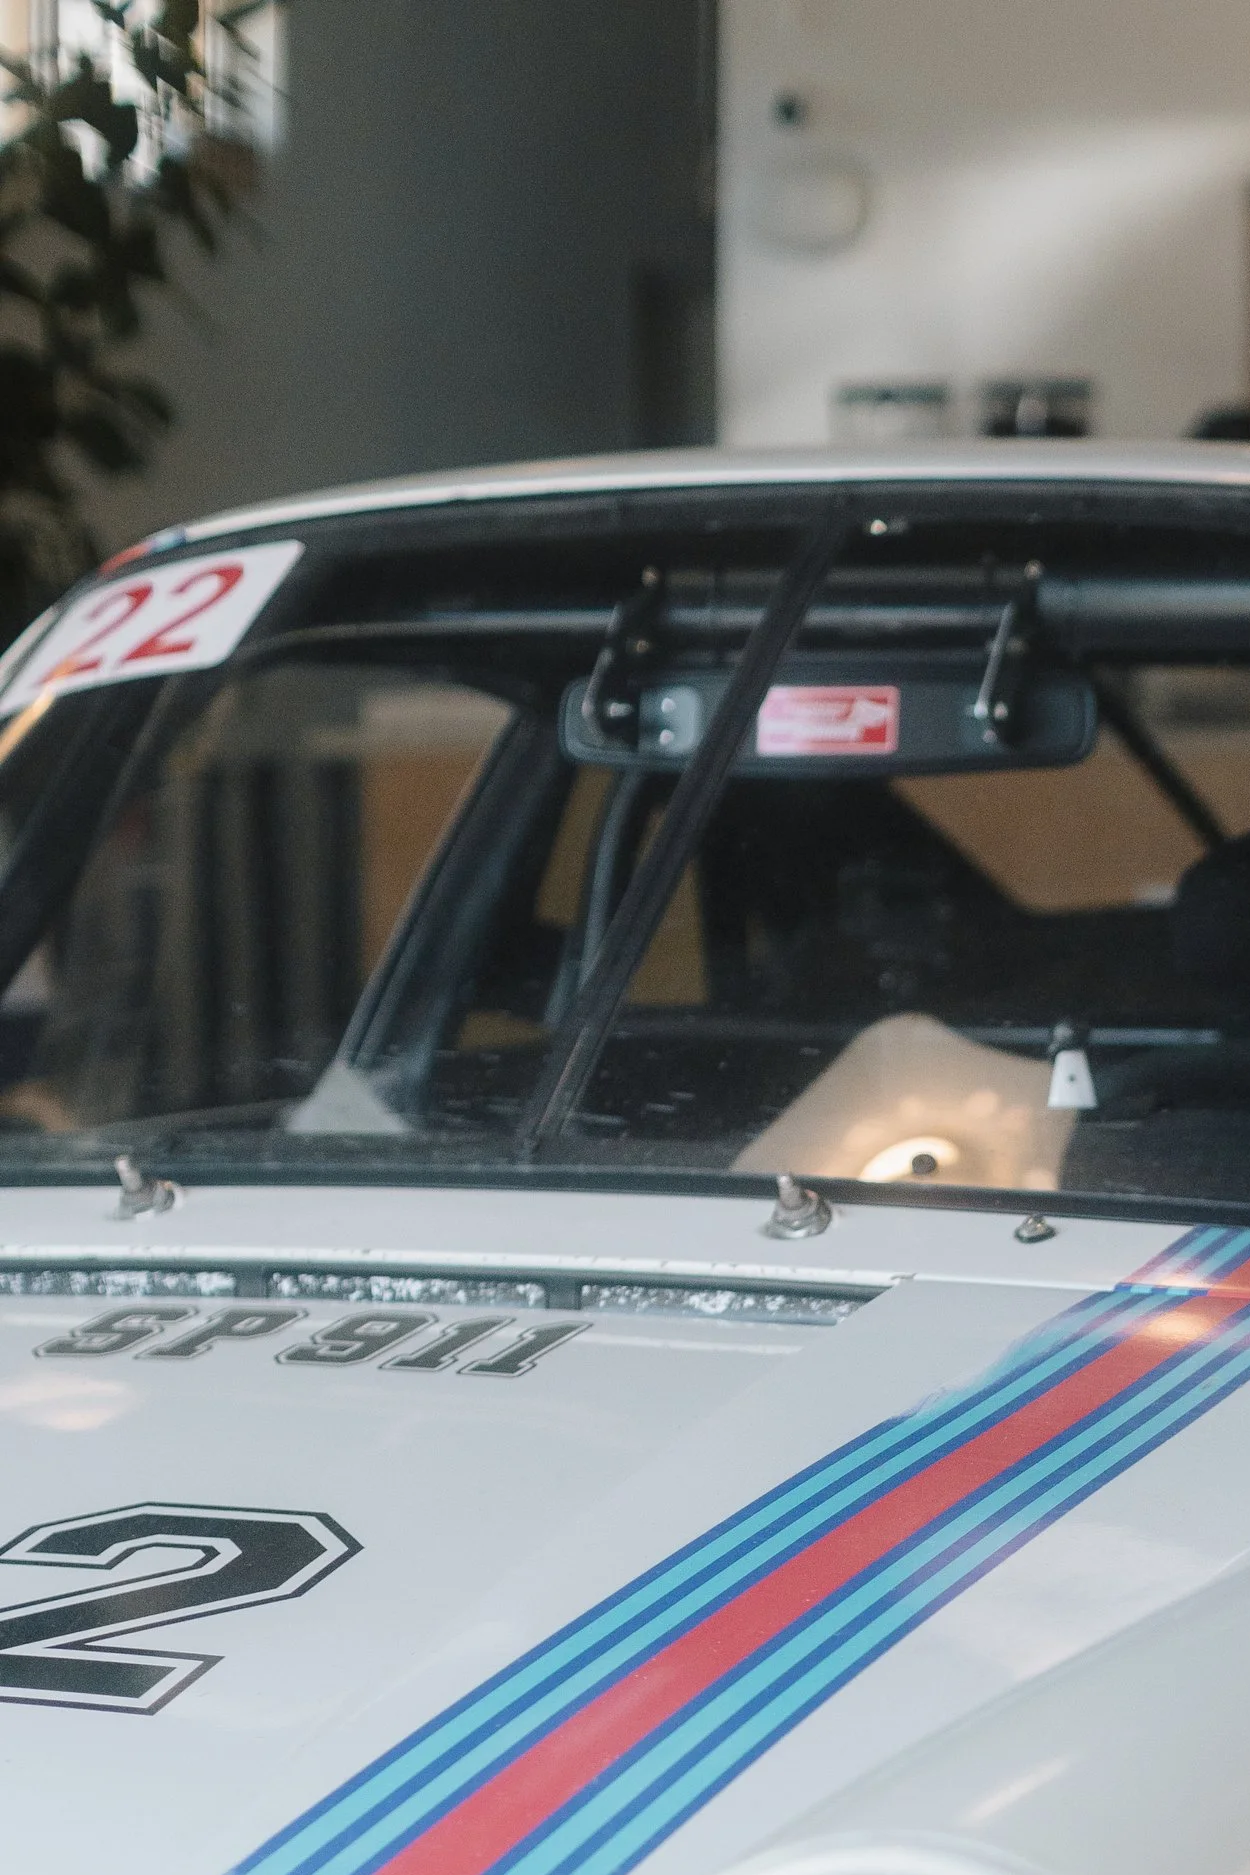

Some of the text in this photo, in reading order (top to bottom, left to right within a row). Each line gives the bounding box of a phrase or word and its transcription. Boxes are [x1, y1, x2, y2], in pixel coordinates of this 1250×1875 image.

[32, 562, 244, 690] 22
[33, 1303, 594, 1378] SP 911
